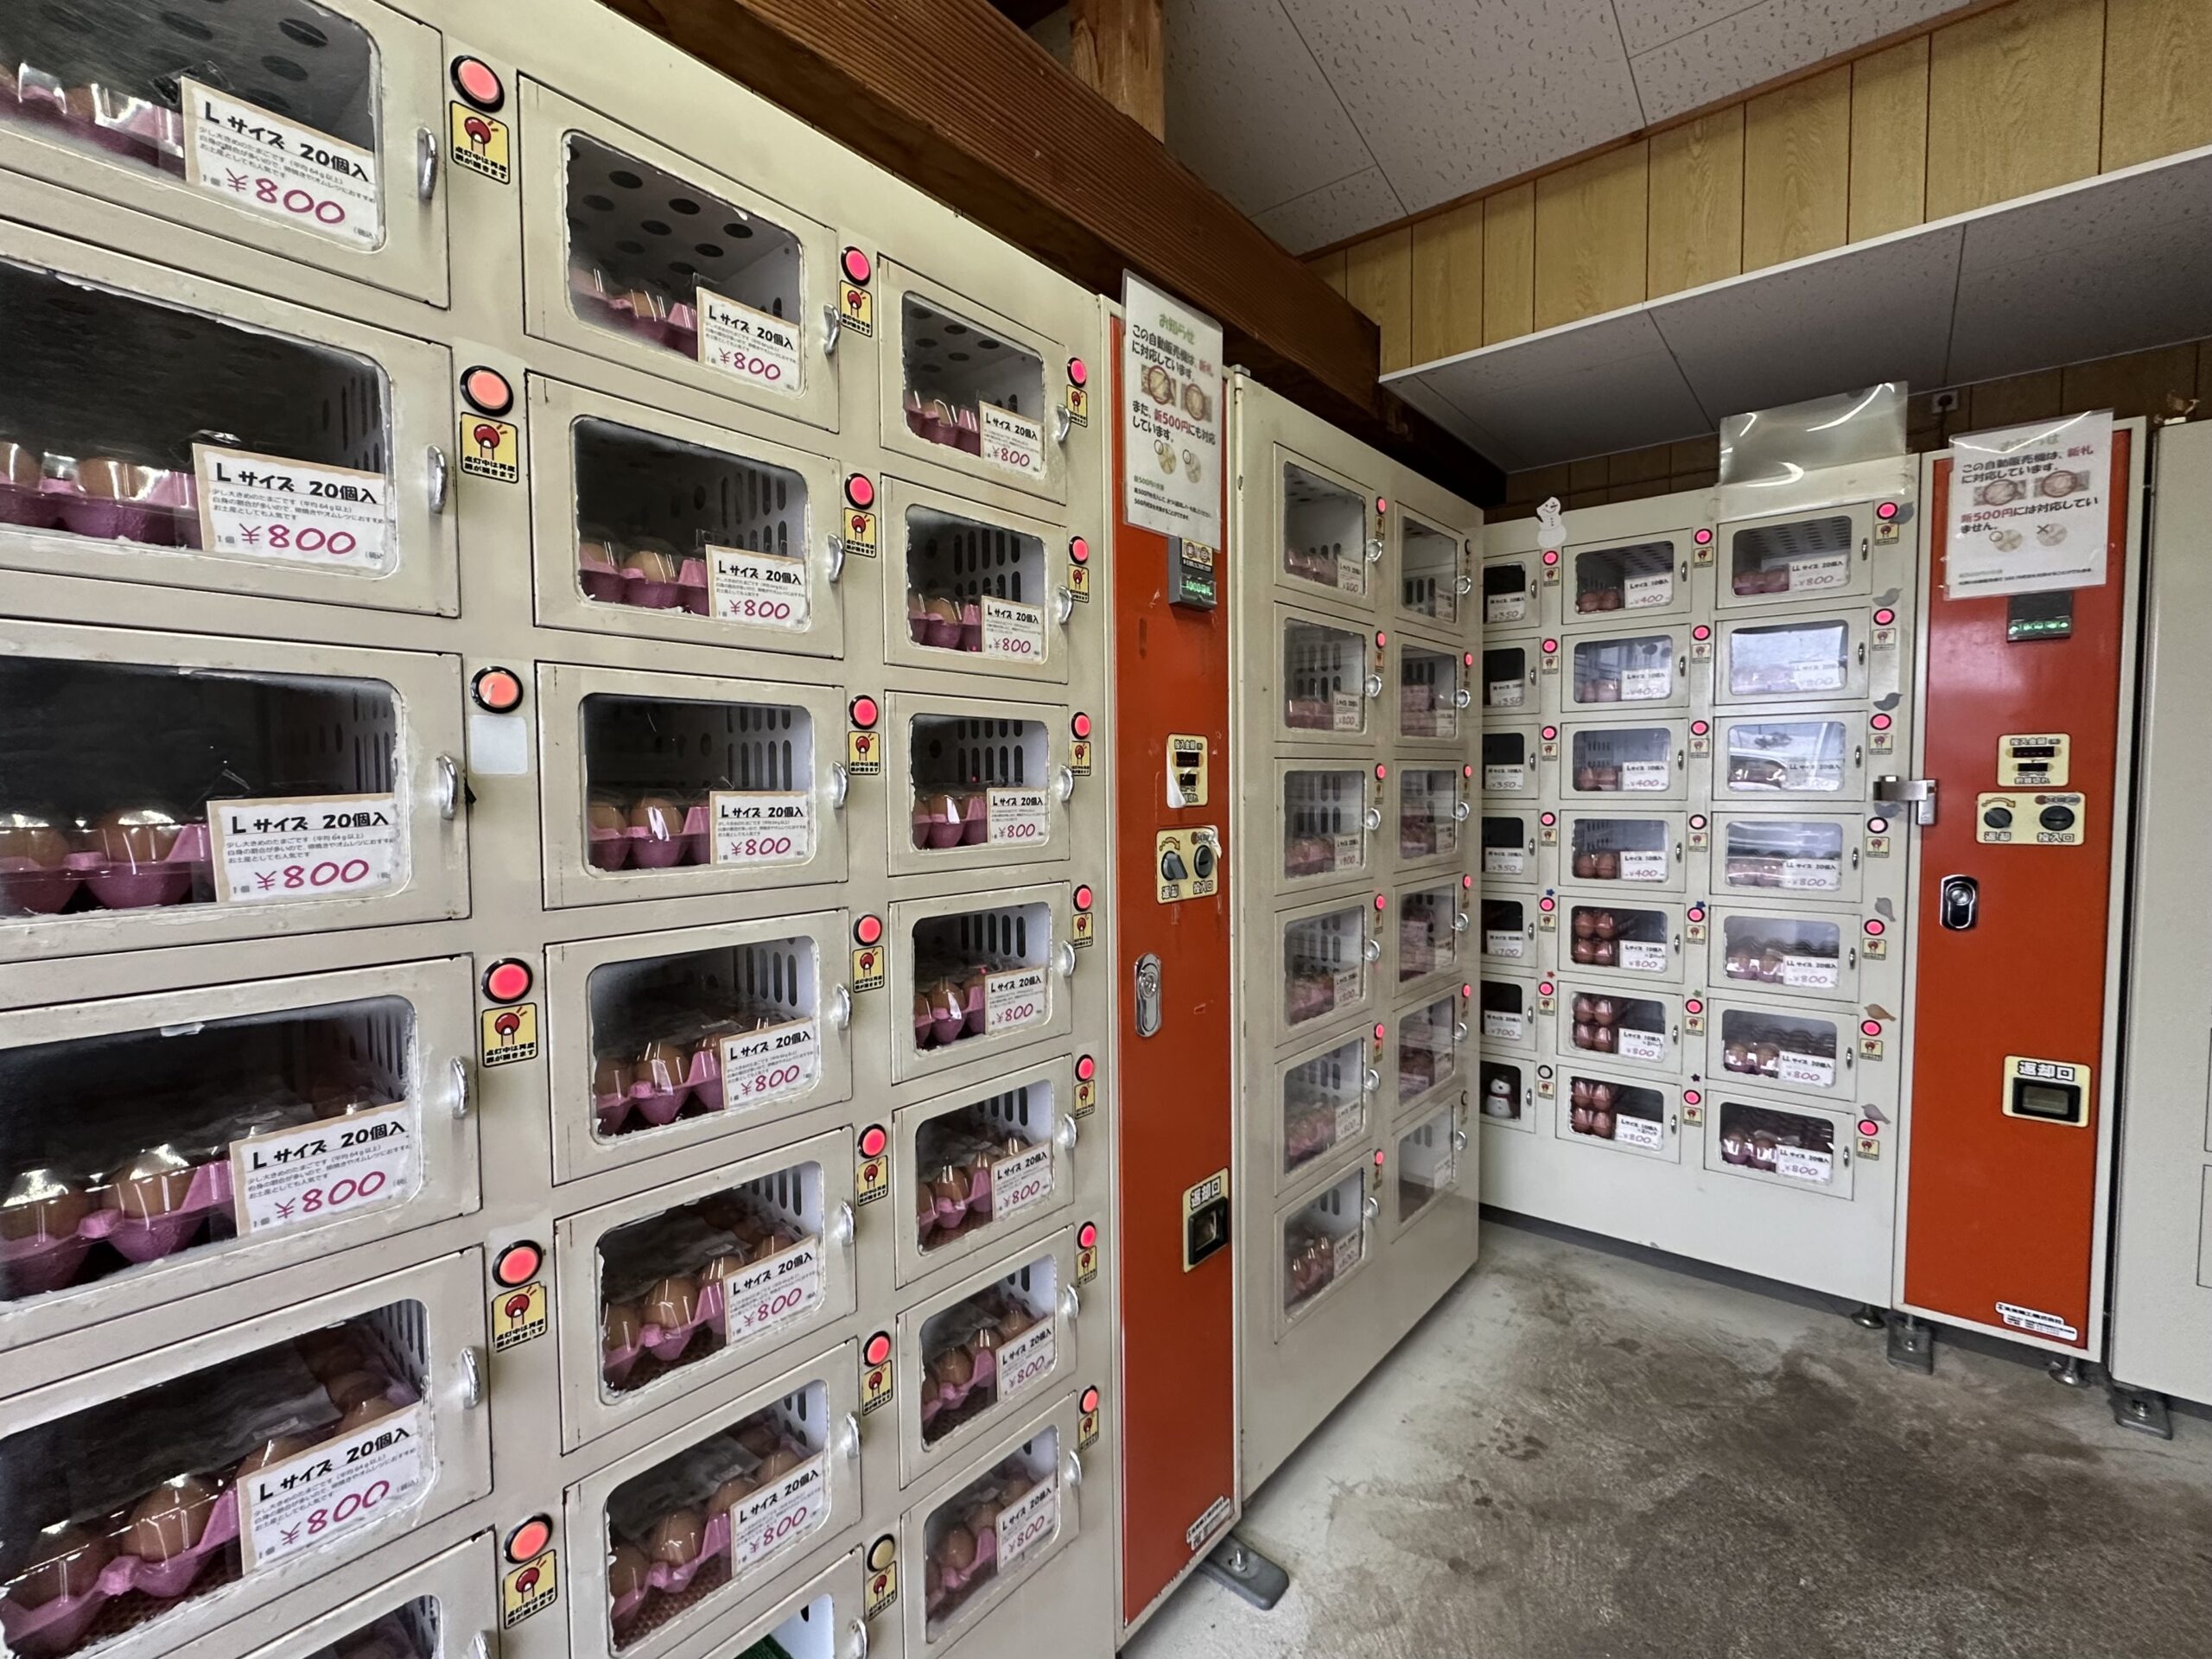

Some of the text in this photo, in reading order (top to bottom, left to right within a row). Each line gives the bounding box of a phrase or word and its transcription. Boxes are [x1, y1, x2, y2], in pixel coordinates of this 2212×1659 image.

[227, 116, 285, 150] サイズ
[300, 143, 370, 182] 20個入
[226, 168, 345, 225] ¥800
[721, 313, 749, 334] サイズ
[757, 327, 793, 351] 20個入
[719, 347, 781, 380] ¥800
[1133, 416, 1174, 443] しています。
[993, 447, 1030, 467] ¥800
[238, 471, 295, 492] サイズ
[308, 480, 377, 504] 20個入
[238, 524, 356, 555] ¥800
[1961, 522, 1998, 534] ません。
[730, 565, 758, 579] サイズ
[766, 569, 801, 585] 20個入
[729, 599, 791, 620] ¥800
[993, 638, 1031, 653] ¥800
[253, 816, 309, 833] サイズ
[322, 811, 389, 830] 20個入
[733, 807, 761, 818] サイズ
[768, 806, 804, 817] 20個入
[731, 837, 791, 855] ¥800
[999, 823, 1036, 838] ¥800
[1984, 831, 2011, 842] 返却
[2037, 833, 2075, 843] 投入口
[254, 859, 369, 891] ¥800
[995, 1002, 1034, 1023] ¥800
[741, 1041, 769, 1058] サイズ
[776, 1031, 811, 1048] 20個入
[741, 1065, 799, 1096] ¥800
[2018, 1060, 2075, 1082] 返却口
[274, 1140, 327, 1164] サイズ
[340, 1121, 406, 1148] 20個入
[275, 1171, 386, 1219] ¥800
[1002, 1179, 1040, 1208] ¥800
[1190, 1177, 1221, 1210] 返却口
[744, 1269, 772, 1289] サイズ
[779, 1251, 812, 1274] 20個入
[743, 1287, 802, 1327] ¥800
[1008, 1355, 1045, 1389] ¥800
[280, 1459, 333, 1491] サイズ
[346, 1427, 410, 1465] 20個入
[751, 1493, 778, 1515] サイズ
[784, 1469, 819, 1497] 20個入
[280, 1479, 391, 1547] ¥800
[749, 1507, 807, 1553] ¥800
[1008, 1515, 1045, 1553] ¥800
